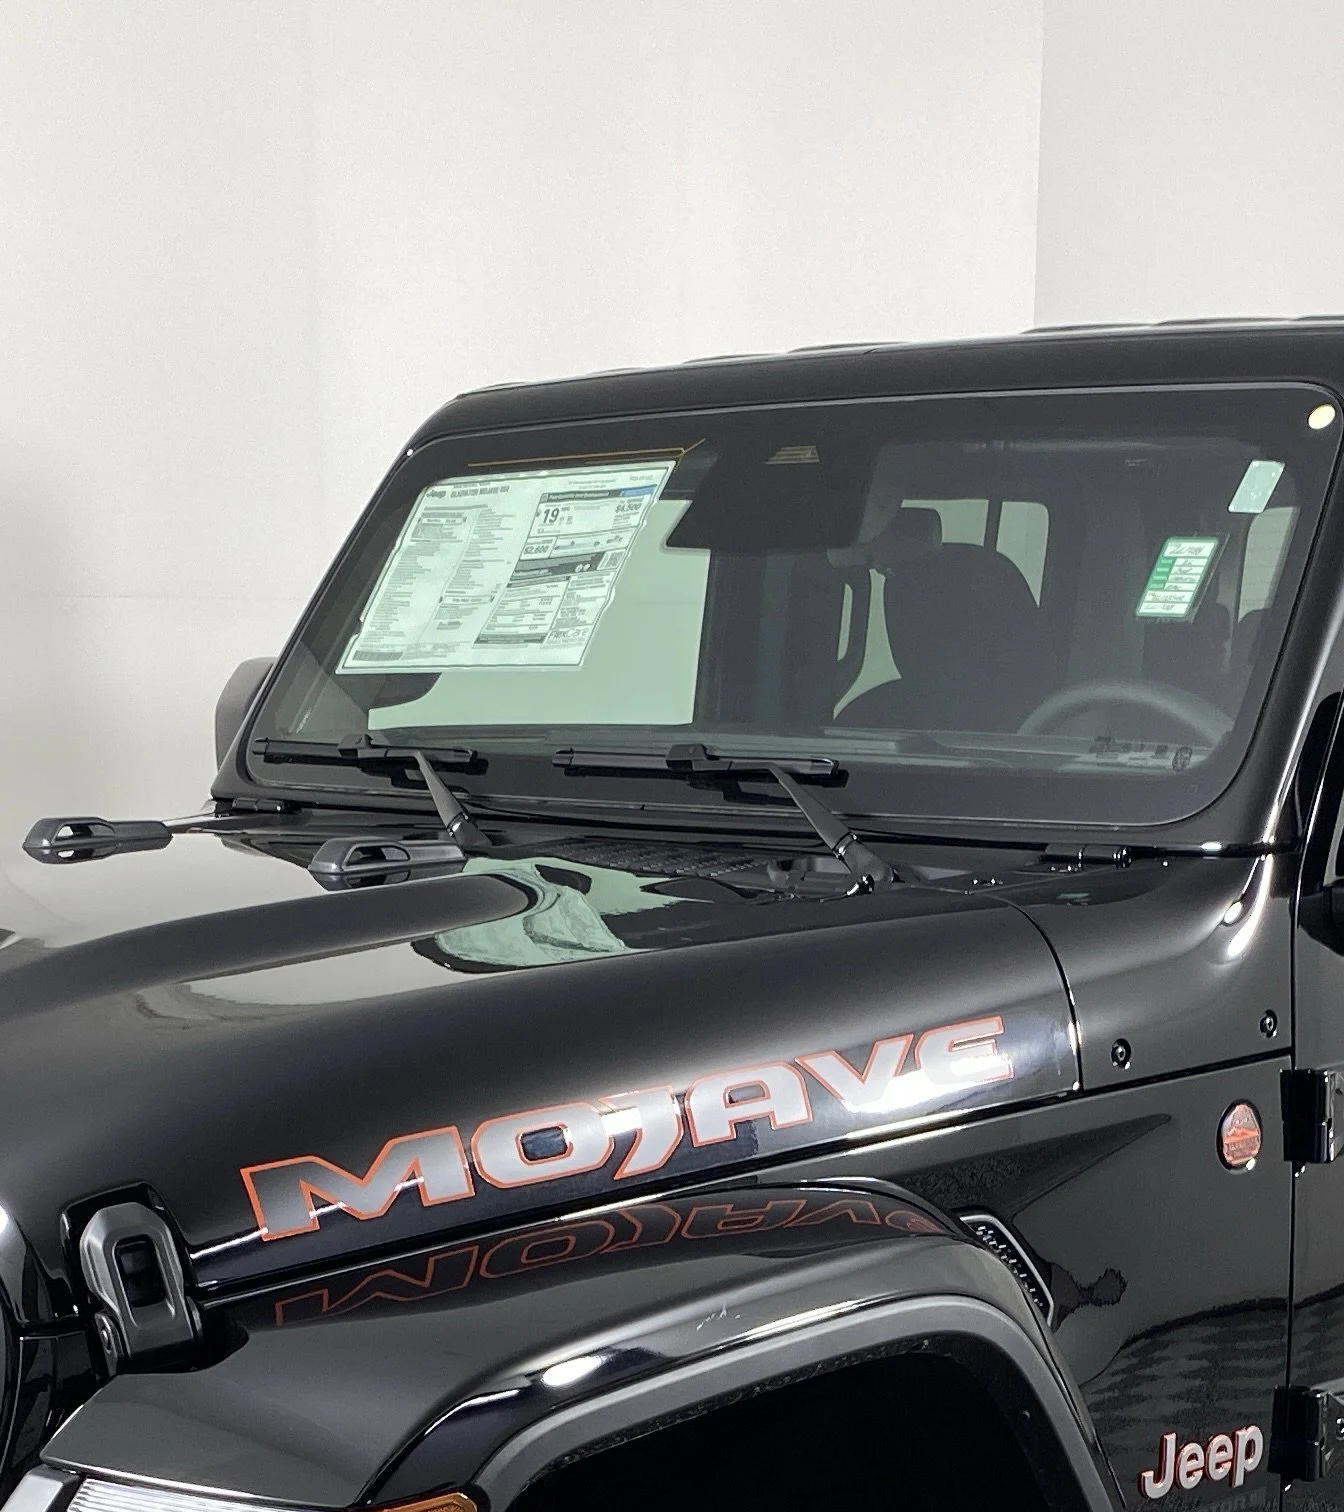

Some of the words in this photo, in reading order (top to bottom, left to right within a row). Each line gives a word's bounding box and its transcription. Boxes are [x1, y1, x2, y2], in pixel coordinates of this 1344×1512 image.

[543, 508, 559, 523] 19
[240, 1016, 1014, 1241] MOJAVE
[1137, 1424, 1264, 1499] Jeep
